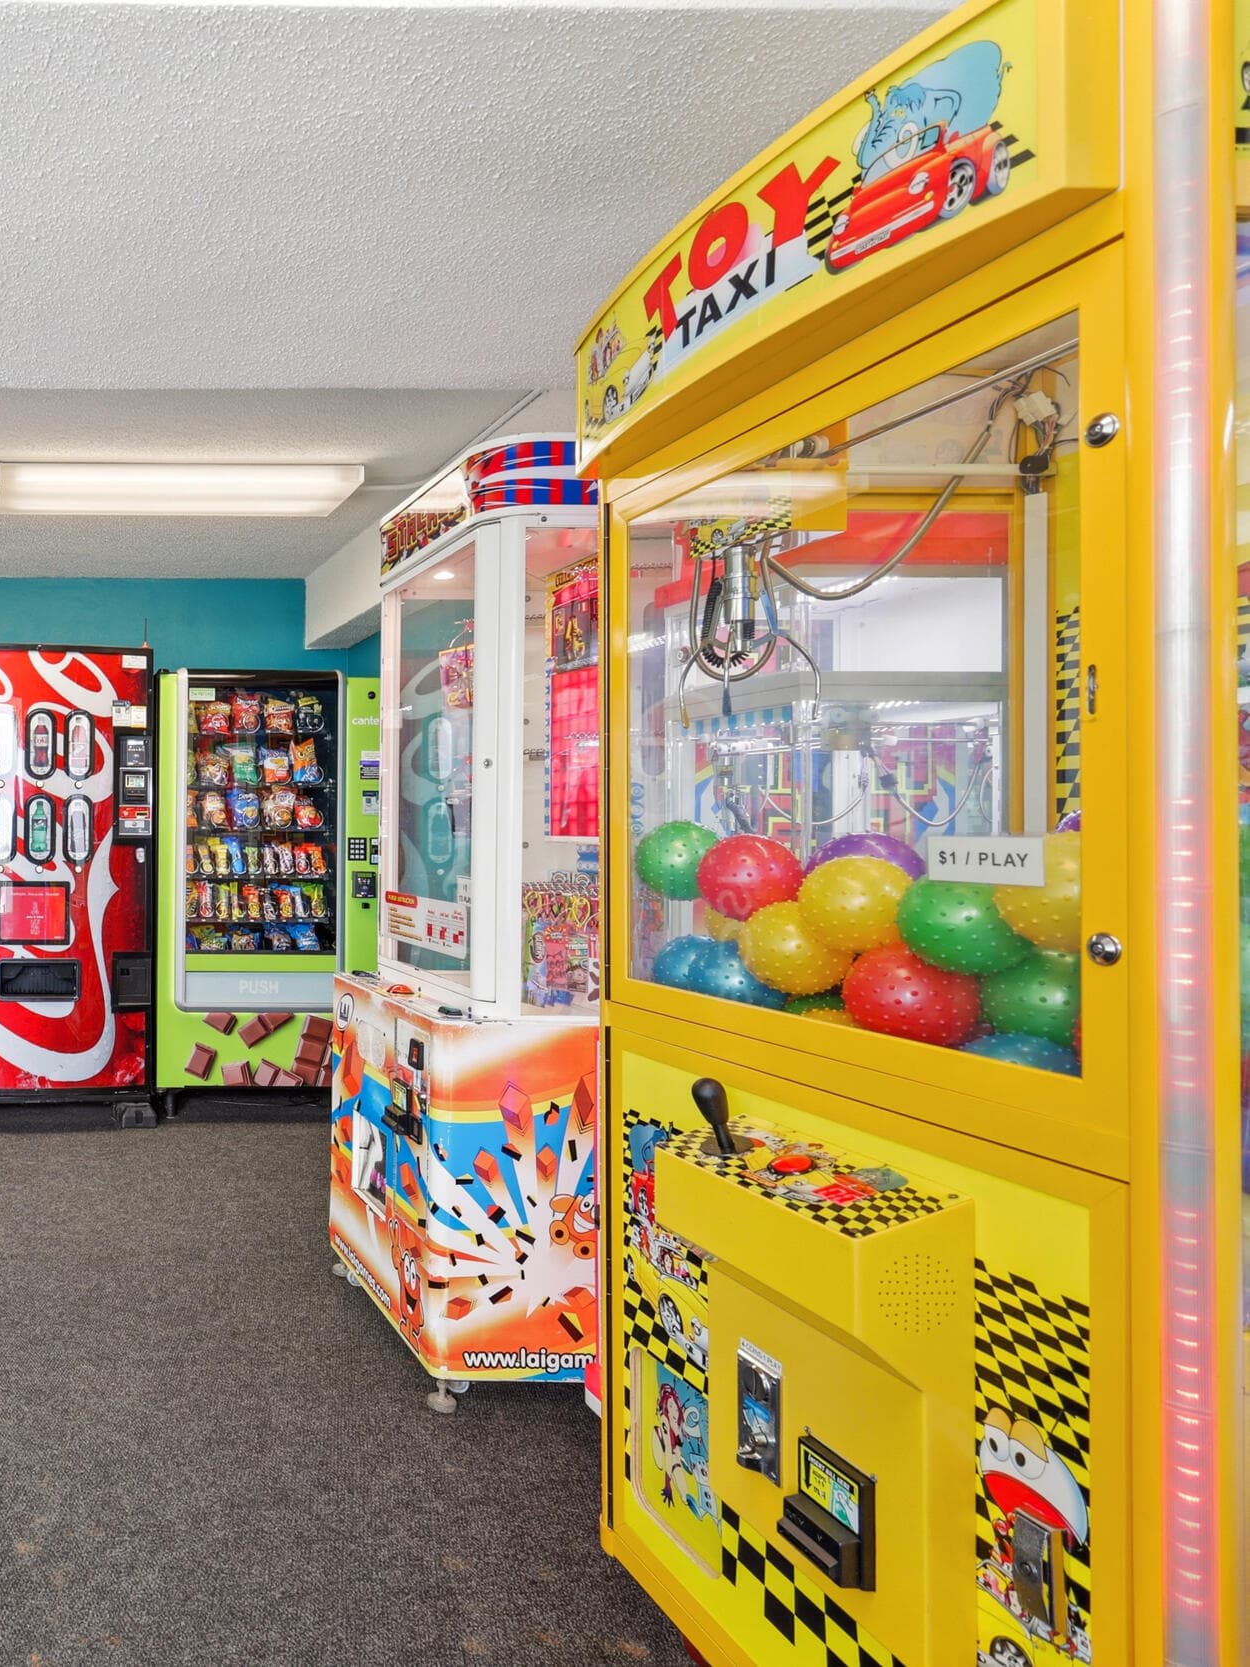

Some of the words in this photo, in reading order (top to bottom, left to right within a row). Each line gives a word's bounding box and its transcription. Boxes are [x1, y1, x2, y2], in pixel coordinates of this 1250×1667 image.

[643, 156, 841, 342] TOY
[676, 246, 778, 349] TAXI
[938, 850, 956, 866] $1
[978, 852, 1029, 868] PLAY
[238, 979, 279, 995] PUSH
